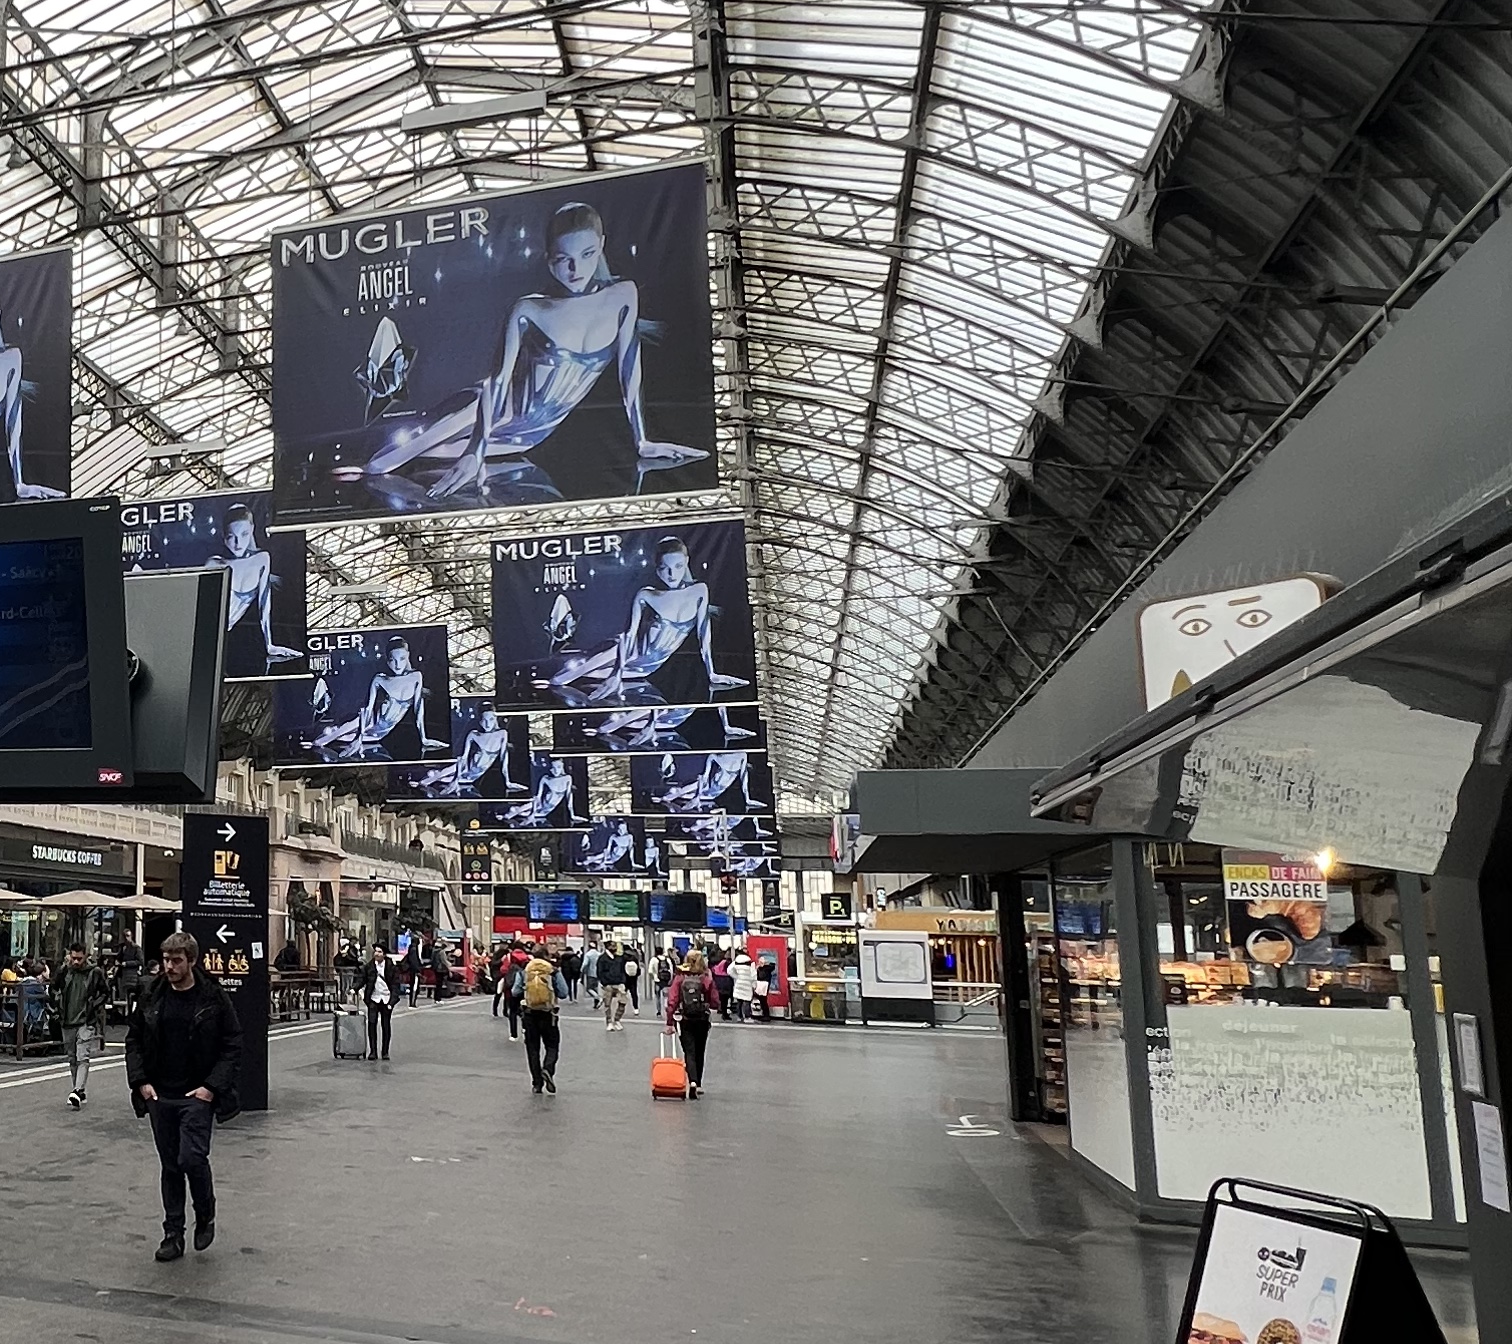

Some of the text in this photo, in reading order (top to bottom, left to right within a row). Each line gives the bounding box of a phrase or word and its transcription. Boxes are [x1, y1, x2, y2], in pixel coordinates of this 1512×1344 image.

[281, 206, 490, 267] MUGLER
[357, 264, 414, 302] ANGEL
[121, 502, 194, 526] GLER
[121, 534, 152, 553] ANGEL
[496, 534, 623, 562] MUGLER
[543, 565, 578, 585] ANGEL
[308, 634, 364, 651] GLER
[99, 772, 123, 782] SNCF
[32, 845, 77, 863] STARBUCKS
[1228, 867, 1267, 879] ENCAS
[1272, 867, 1288, 880] DE
[1256, 1264, 1299, 1288] SUPER
[1260, 1281, 1287, 1302] PRIX
